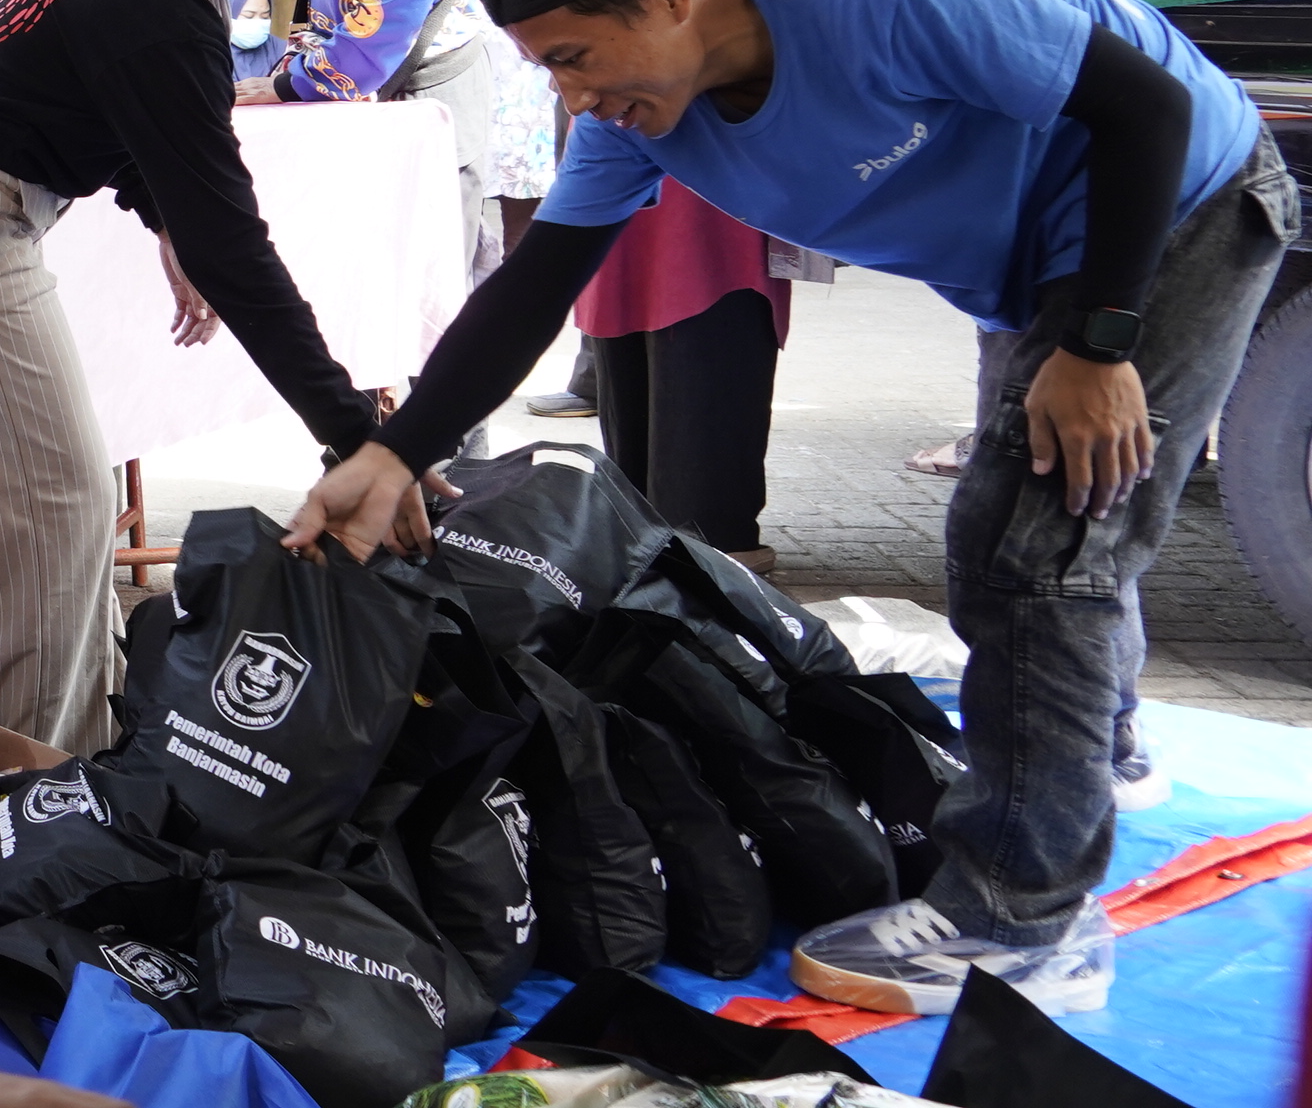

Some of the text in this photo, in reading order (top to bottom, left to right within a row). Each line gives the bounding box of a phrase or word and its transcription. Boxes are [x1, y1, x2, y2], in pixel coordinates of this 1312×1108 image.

[867, 121, 928, 170] bulog
[446, 530, 583, 604] BANK INDONESIA
[164, 710, 291, 785] Pemerintah Kota
[166, 736, 266, 798] Banjarmasin
[304, 937, 360, 969] BANK
